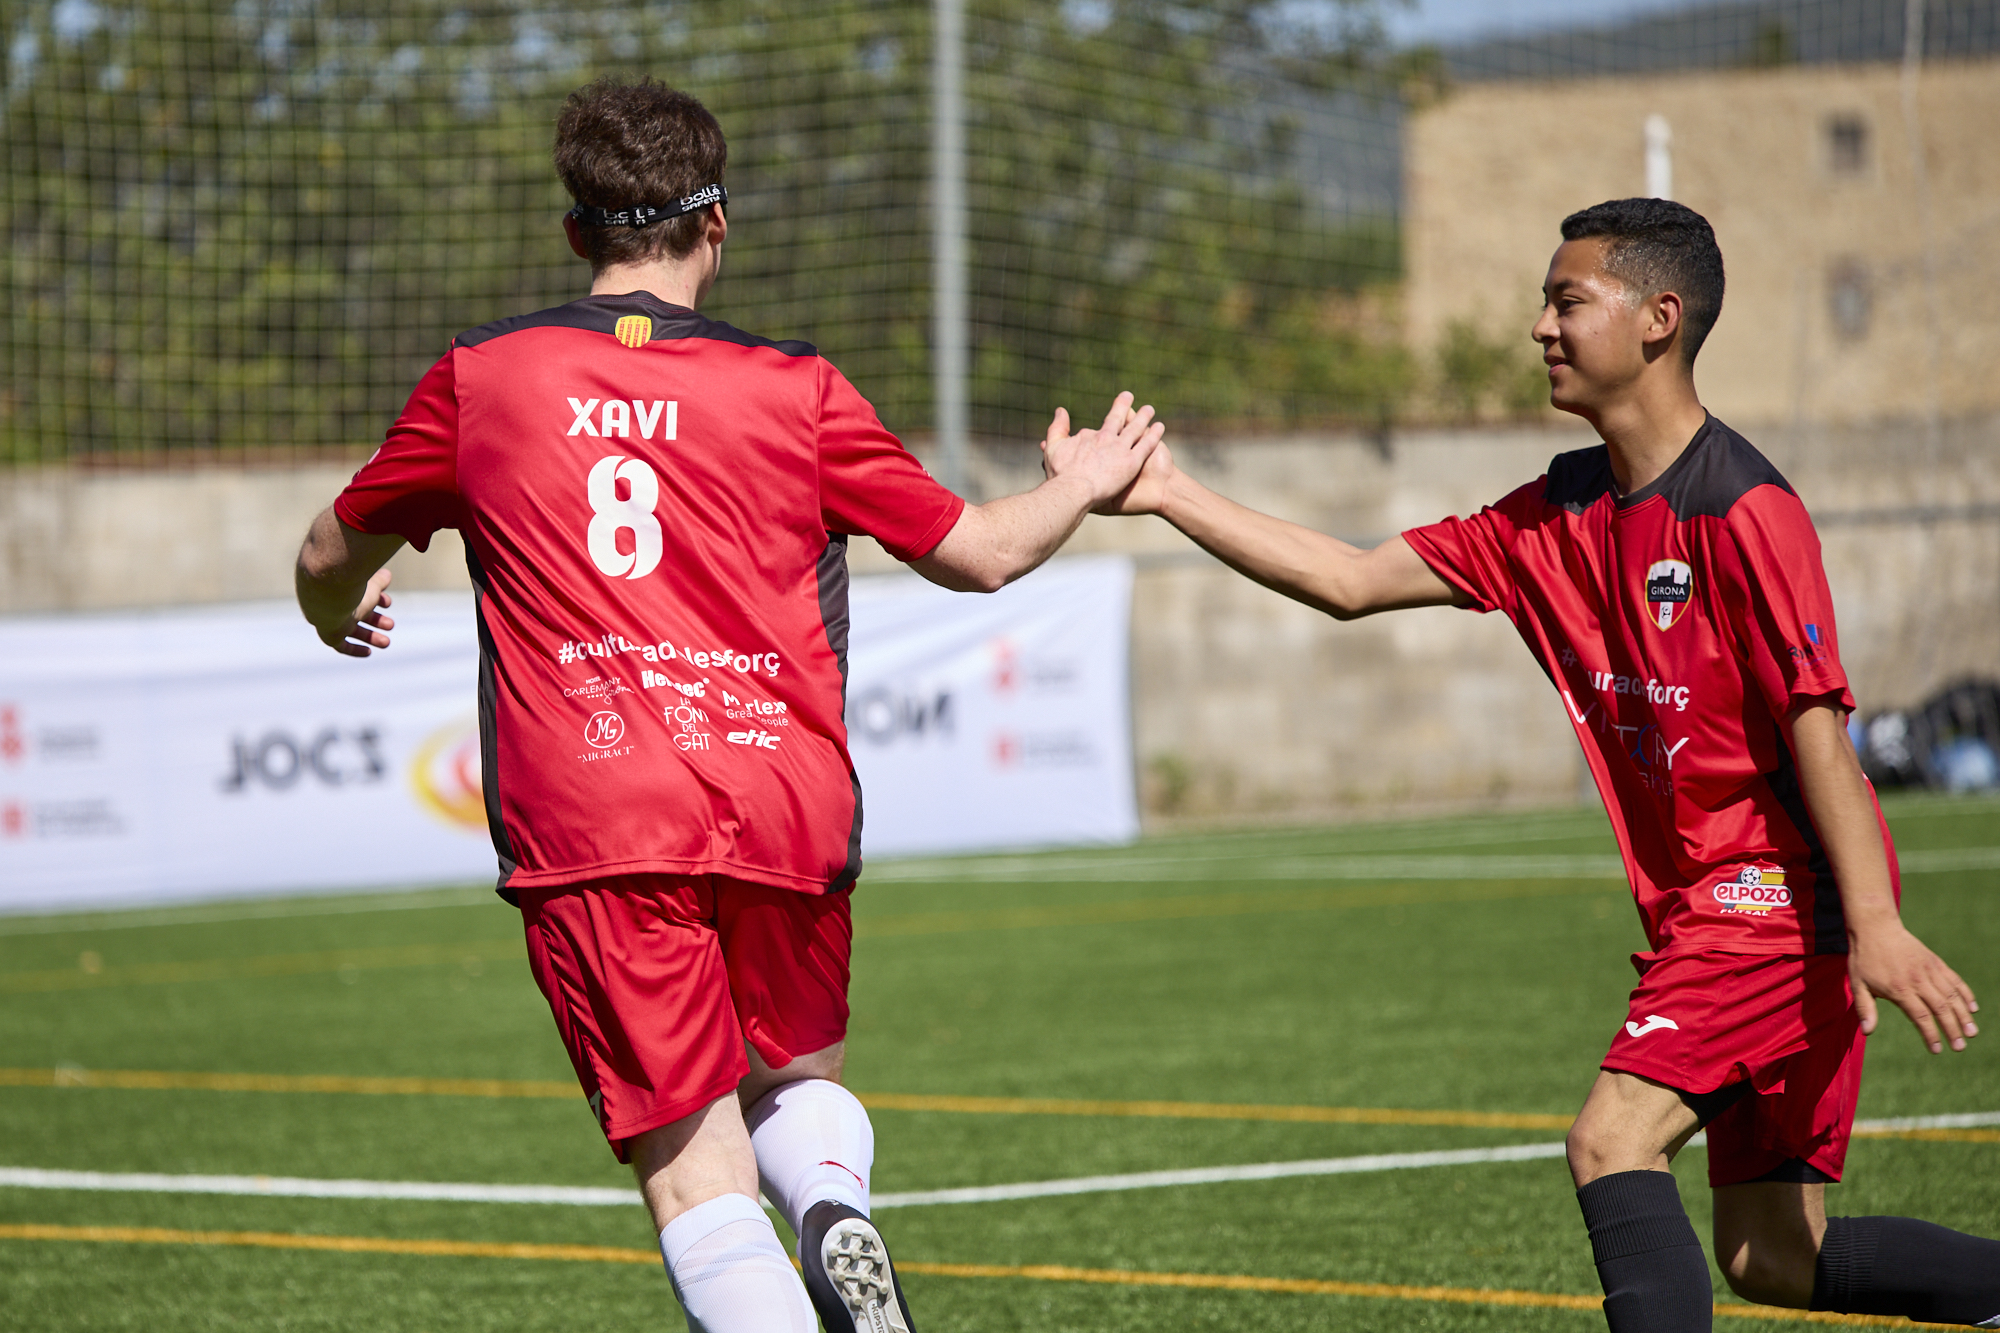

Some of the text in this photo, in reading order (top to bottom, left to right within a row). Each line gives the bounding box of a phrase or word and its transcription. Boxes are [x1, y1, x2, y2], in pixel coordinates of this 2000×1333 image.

[681, 195, 720, 212] SAFETY
[566, 397, 678, 440] XAVI
[587, 455, 663, 580] 8
[1651, 586, 1685, 596] GIRONA
[559, 632, 781, 677] #cultuadlesforç
[563, 677, 621, 698] CARLEMANY
[680, 697, 691, 706] LA
[722, 690, 787, 715] Mrlex
[726, 709, 757, 718] Grea
[682, 723, 698, 732] DEL
[673, 733, 710, 751] GAT
[1720, 909, 1769, 917] FUTSAL
